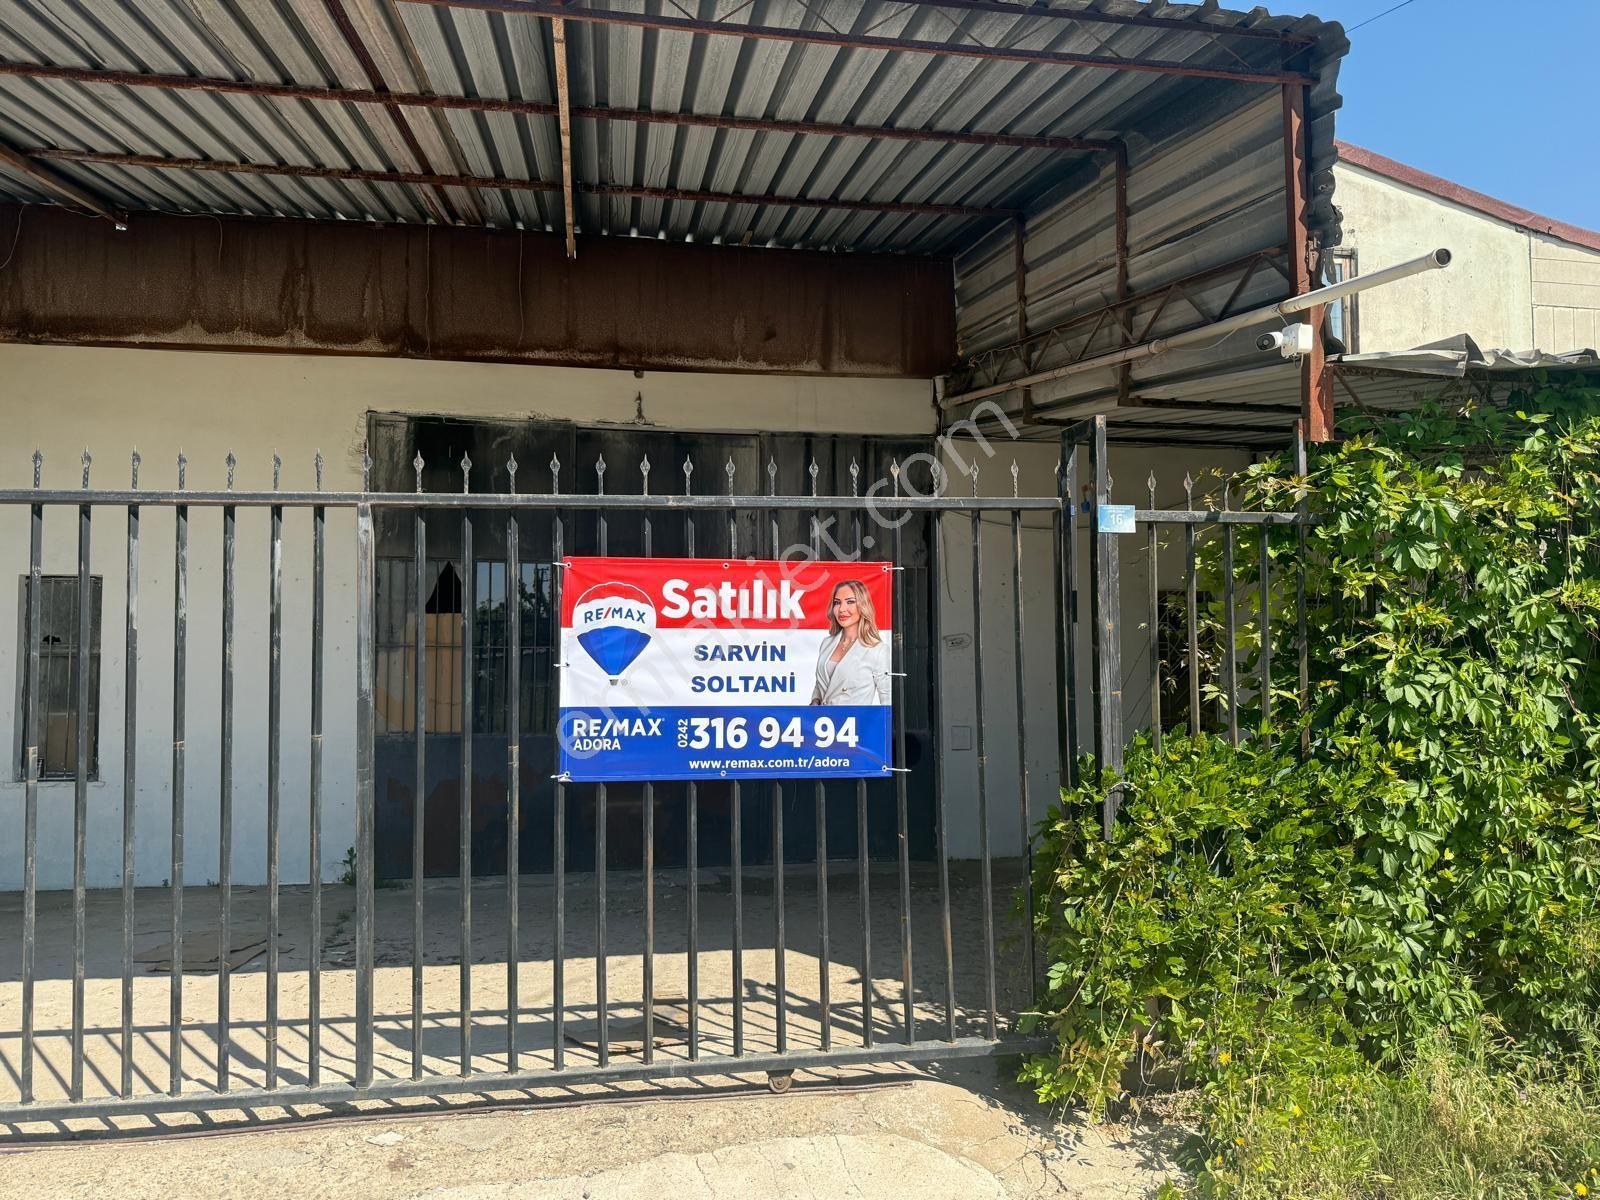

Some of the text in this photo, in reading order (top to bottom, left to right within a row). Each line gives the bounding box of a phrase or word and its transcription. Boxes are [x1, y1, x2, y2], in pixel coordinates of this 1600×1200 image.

[1110, 513, 1123, 525] 16
[661, 578, 806, 620] Satılık
[584, 606, 647, 624] RE/MAX
[693, 641, 787, 662] SARVİN
[691, 672, 796, 693] SOLTANİ
[573, 718, 663, 737] RE/MAX
[677, 716, 859, 750] 0242 316 94 94
[573, 738, 621, 751] ADORA
[689, 756, 850, 770] www.remax.com.tr/adora
